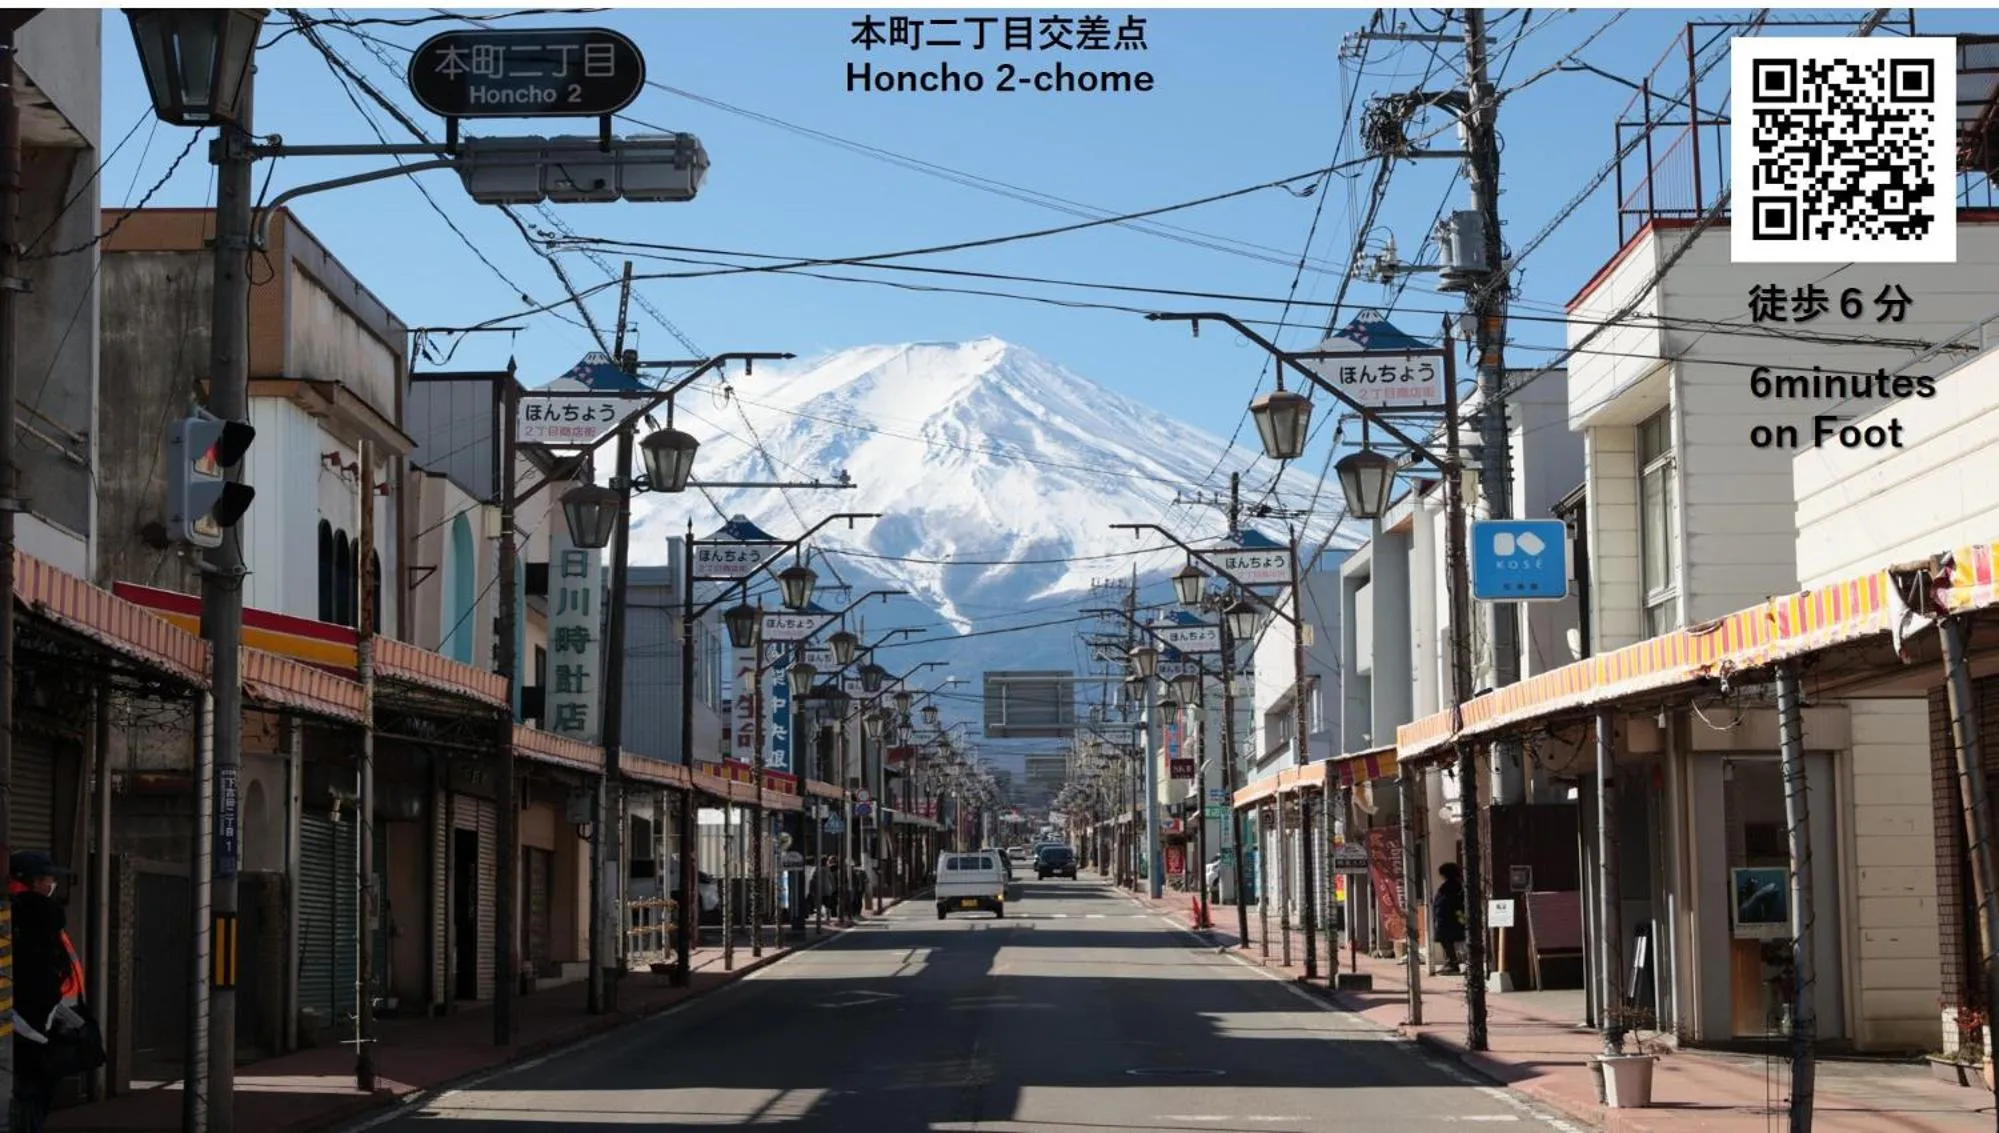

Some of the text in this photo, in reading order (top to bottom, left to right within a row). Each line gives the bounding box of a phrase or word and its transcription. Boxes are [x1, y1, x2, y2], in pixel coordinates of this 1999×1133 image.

[435, 43, 615, 80] 本町二丁目
[469, 84, 582, 104] Honcho 2
[1340, 362, 1435, 385] ほんちょう
[525, 403, 616, 422] ほんちょう
[699, 549, 761, 562] ほんちょう
[1225, 555, 1285, 569] ほんちょう
[553, 550, 591, 732] 日川時計店
